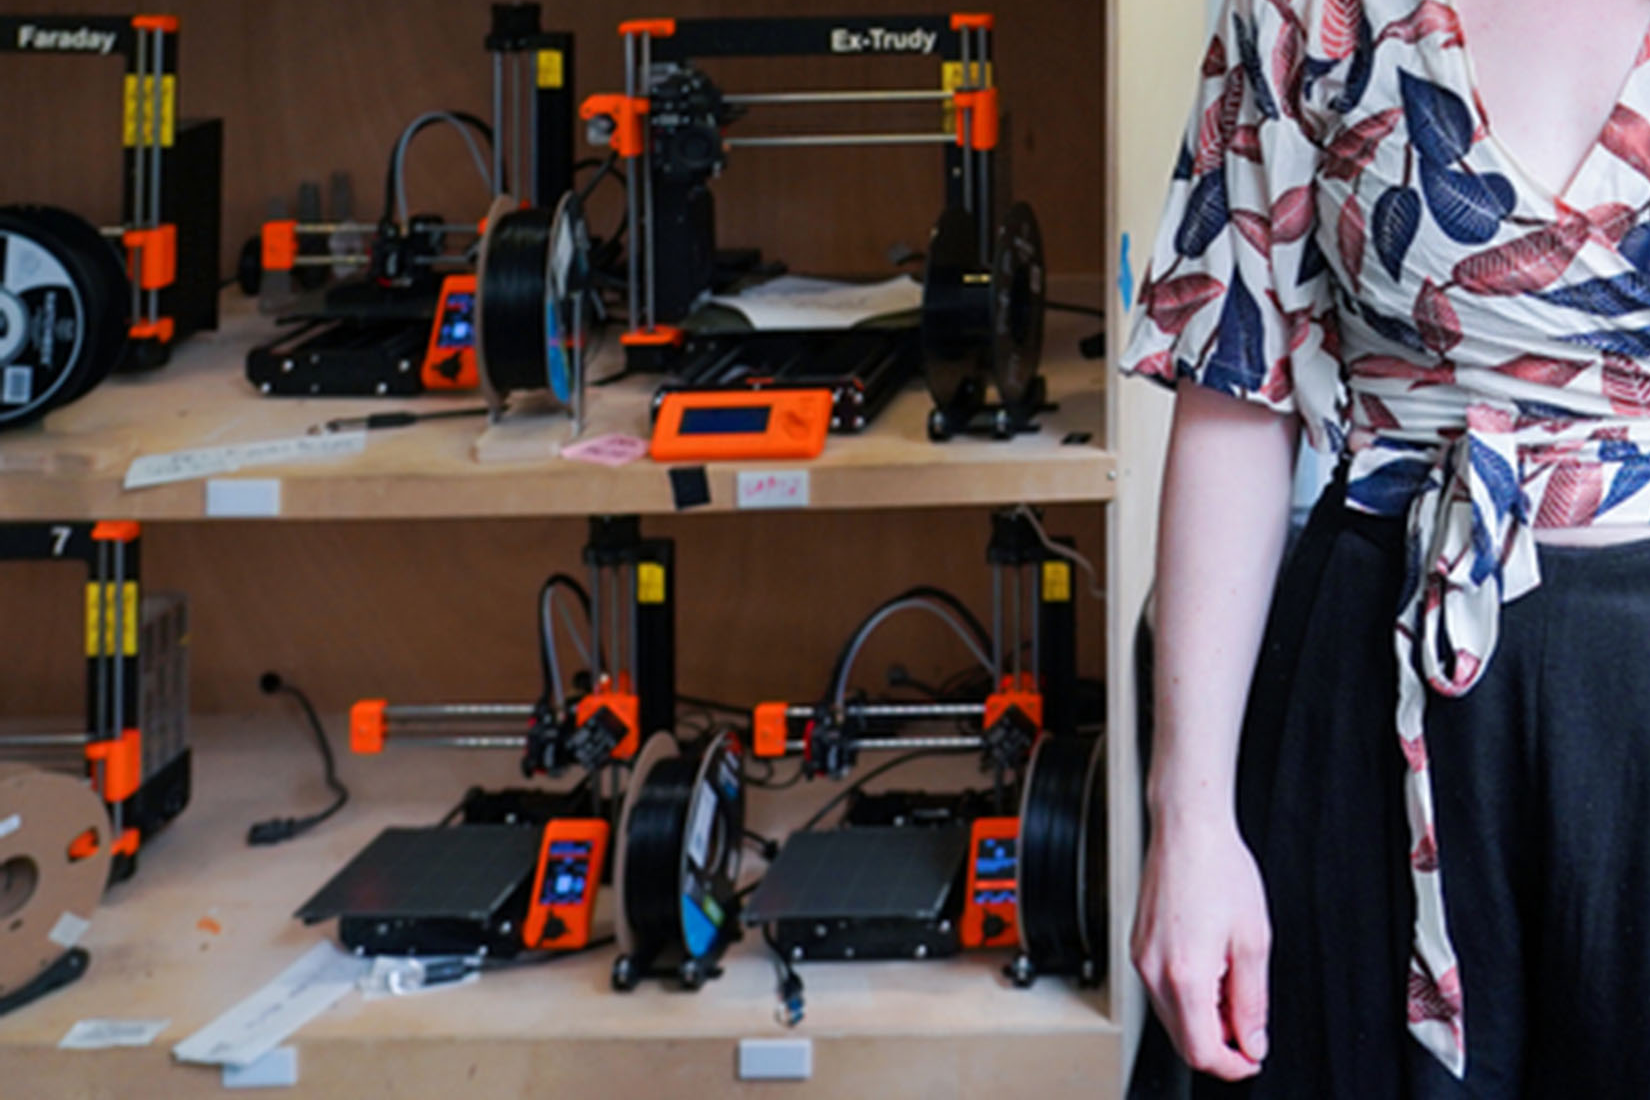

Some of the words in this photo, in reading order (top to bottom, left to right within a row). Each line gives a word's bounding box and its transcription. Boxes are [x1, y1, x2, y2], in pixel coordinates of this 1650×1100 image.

[18, 24, 116, 55] Faraday
[832, 27, 937, 55] Ex-Trudy
[51, 525, 71, 556] 7
